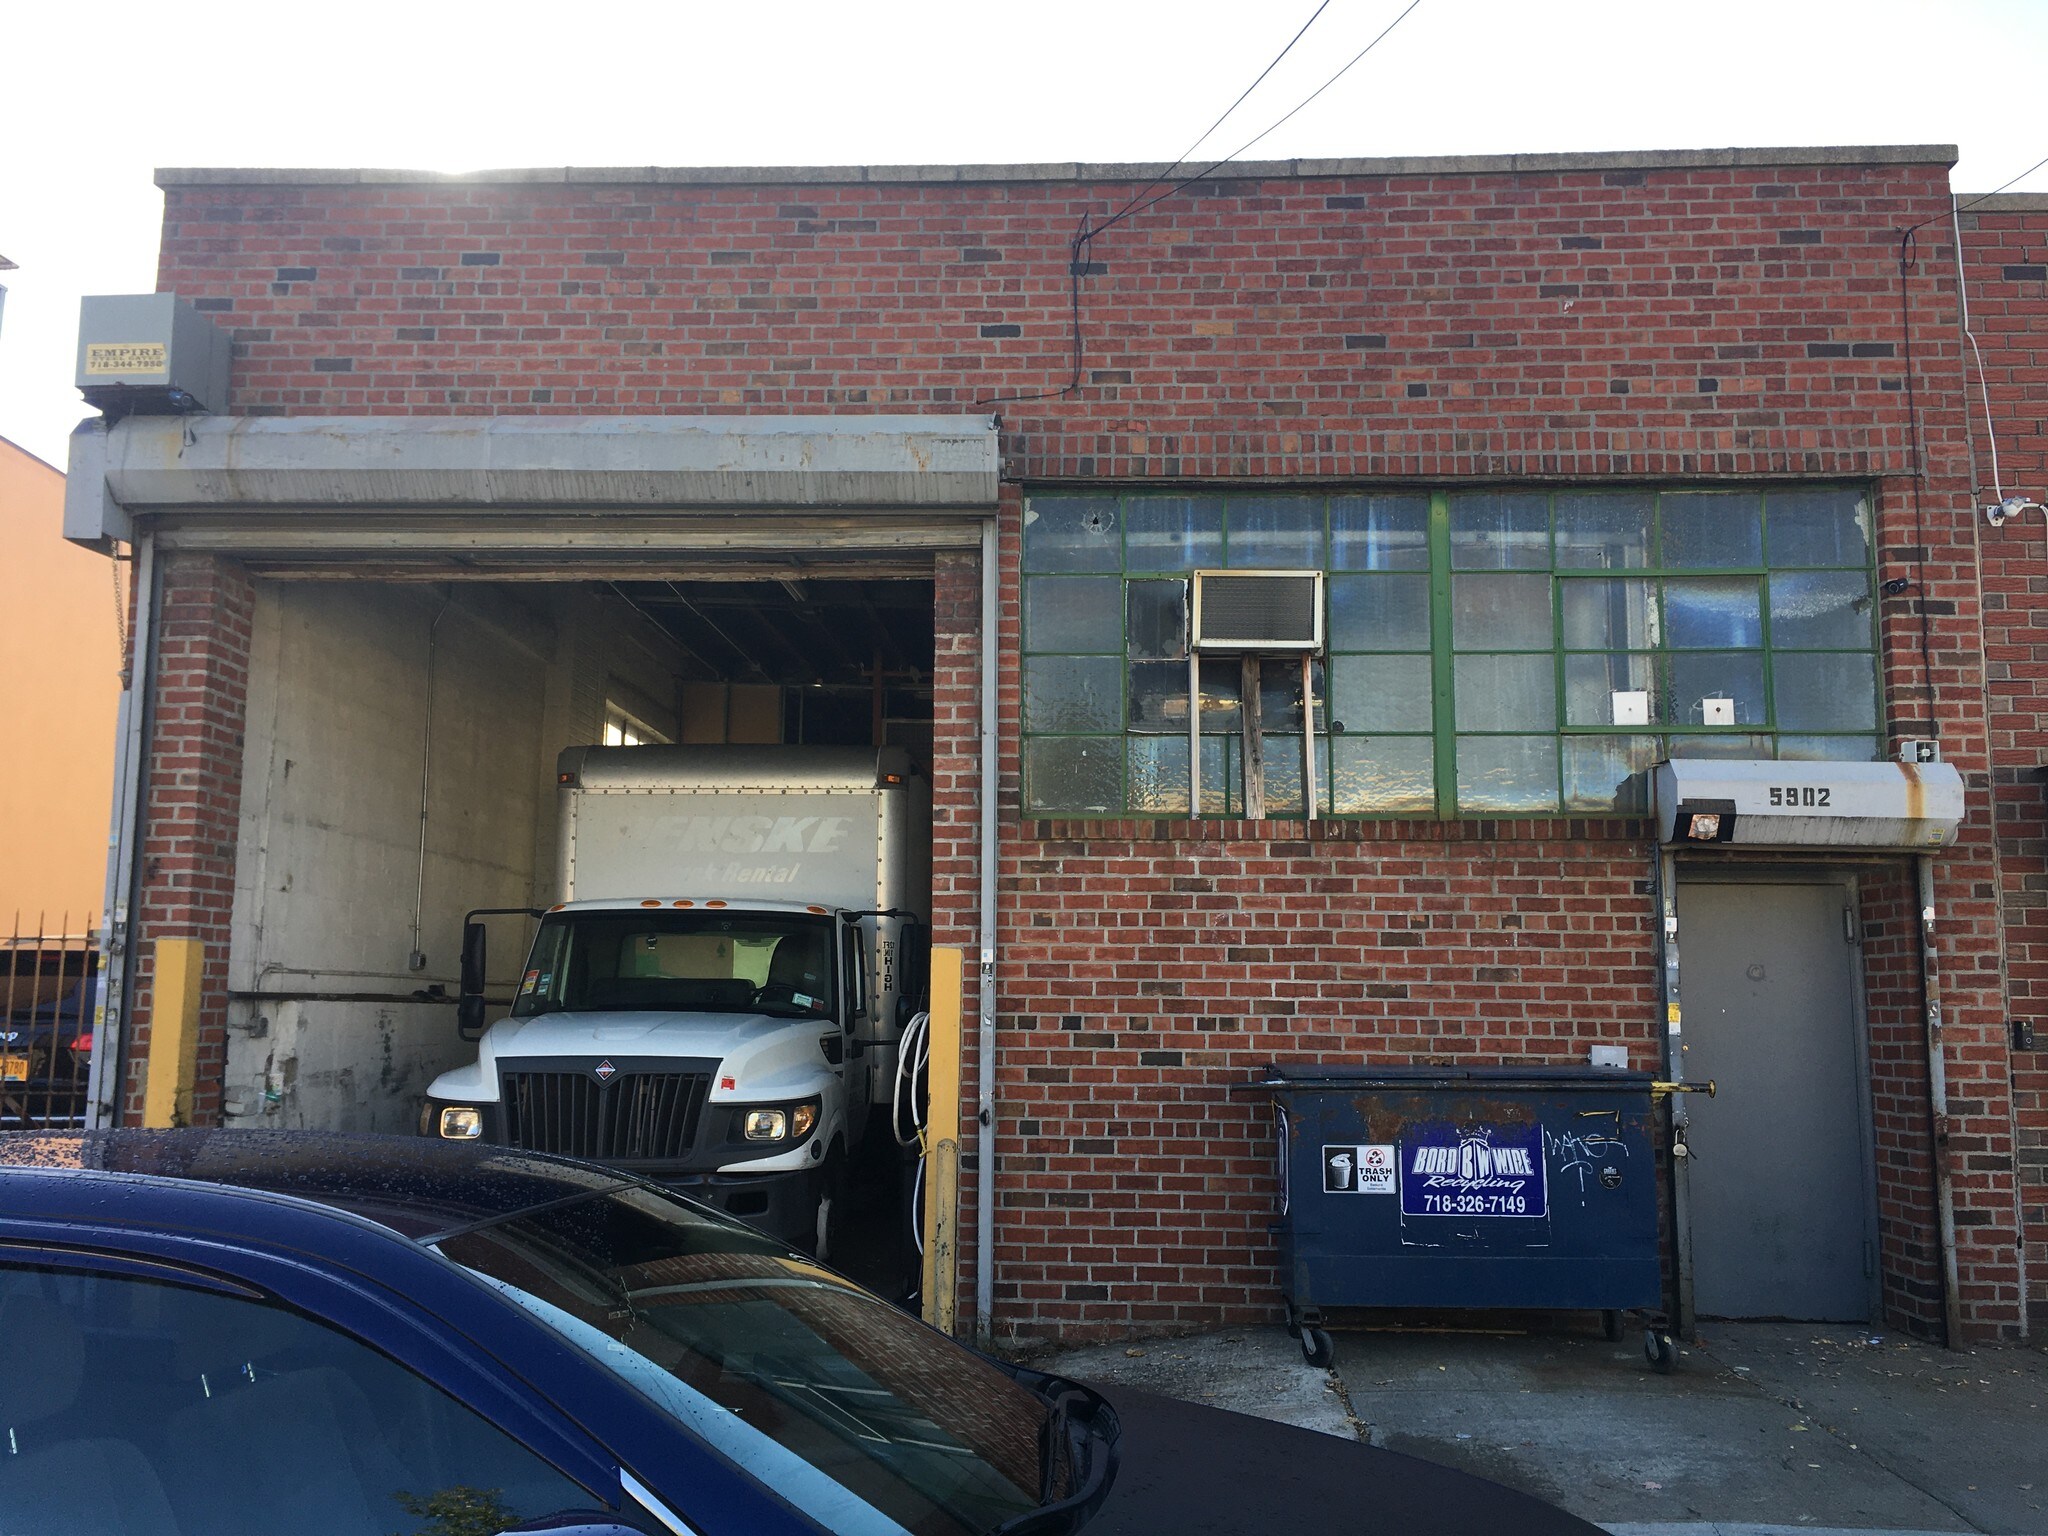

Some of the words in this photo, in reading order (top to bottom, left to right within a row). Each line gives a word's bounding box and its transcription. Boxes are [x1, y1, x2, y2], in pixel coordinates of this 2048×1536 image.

[91, 348, 164, 357] EMPIRE
[1769, 787, 1831, 807] 5902
[720, 861, 802, 884] Rental
[1412, 1146, 1457, 1175] BORO
[1491, 1147, 1534, 1175] WIDE
[1358, 1167, 1392, 1175] TRASH
[1362, 1174, 1389, 1182] ONLY
[1423, 1175, 1525, 1194] Recycling
[1424, 1195, 1526, 1213] 718-326-7149
